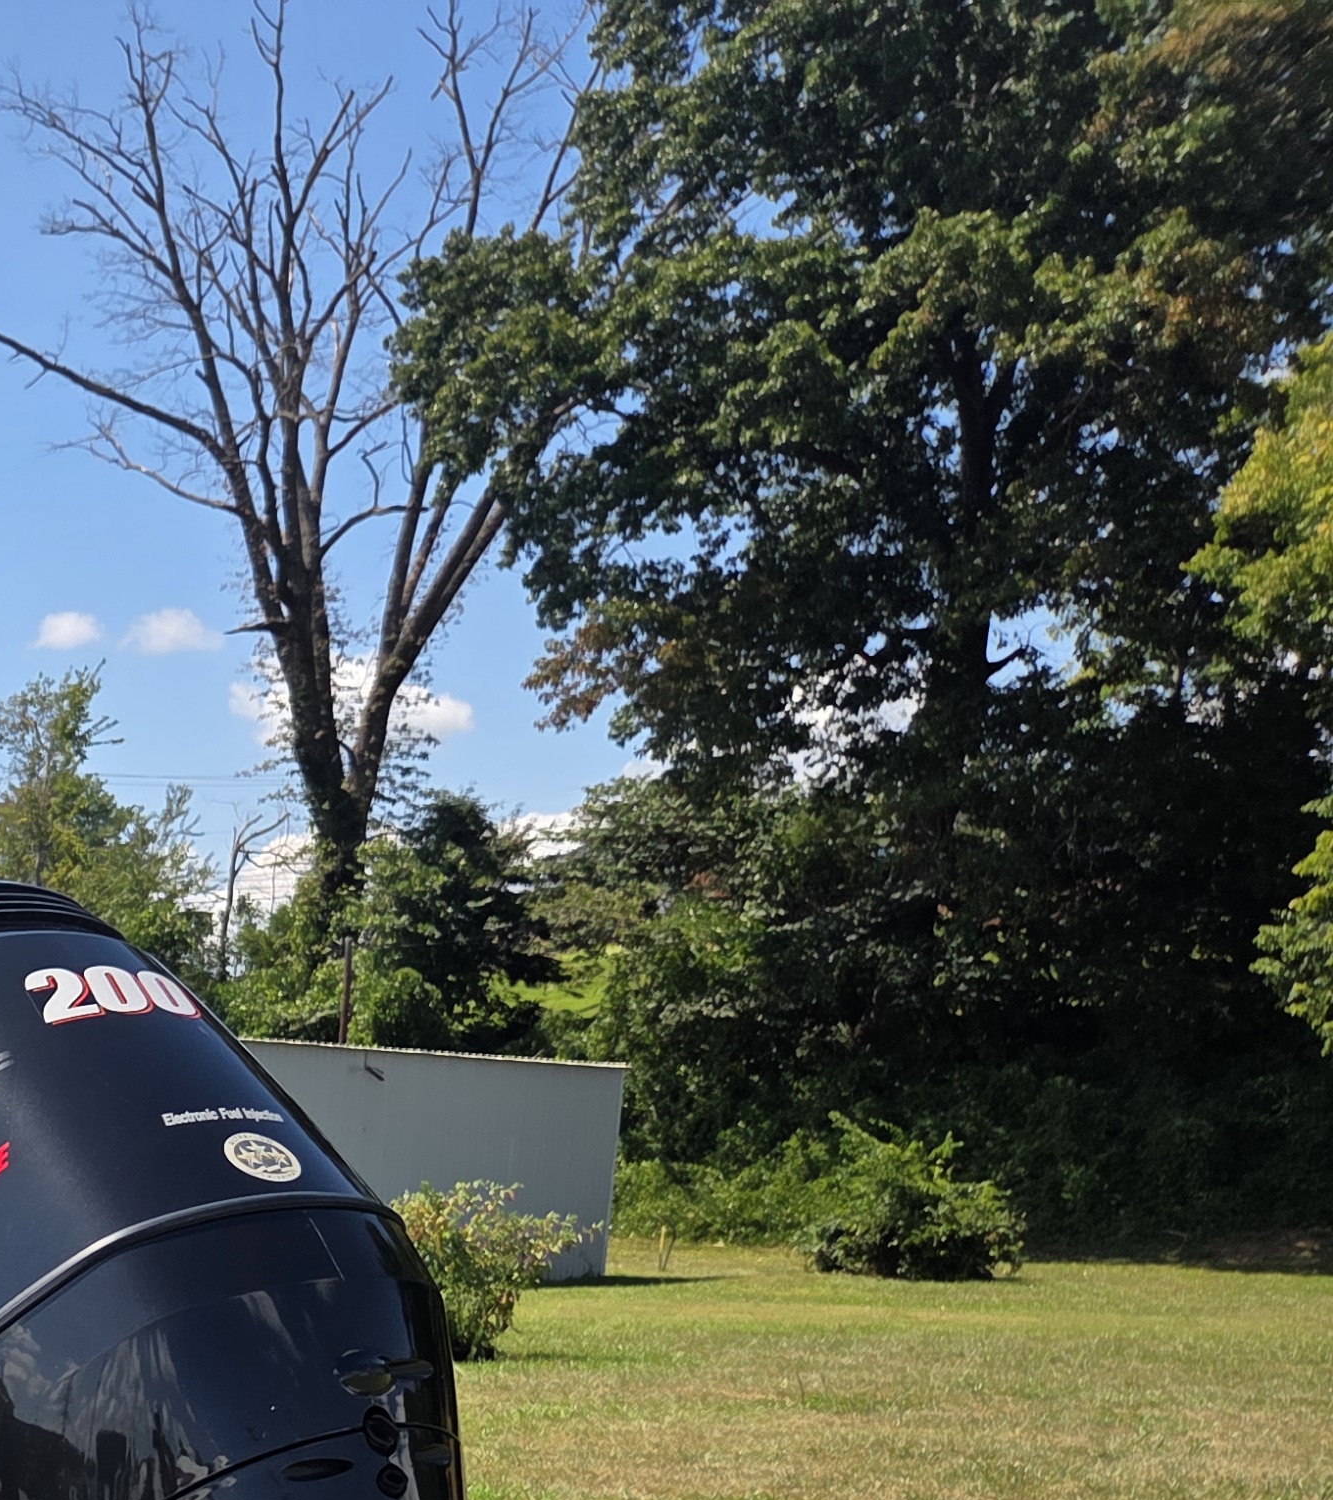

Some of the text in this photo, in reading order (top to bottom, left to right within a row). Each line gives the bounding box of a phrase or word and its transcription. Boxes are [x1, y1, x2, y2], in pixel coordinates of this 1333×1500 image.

[24, 965, 202, 1025] 200
[161, 1107, 284, 1126] Electronic Fuel Injection
